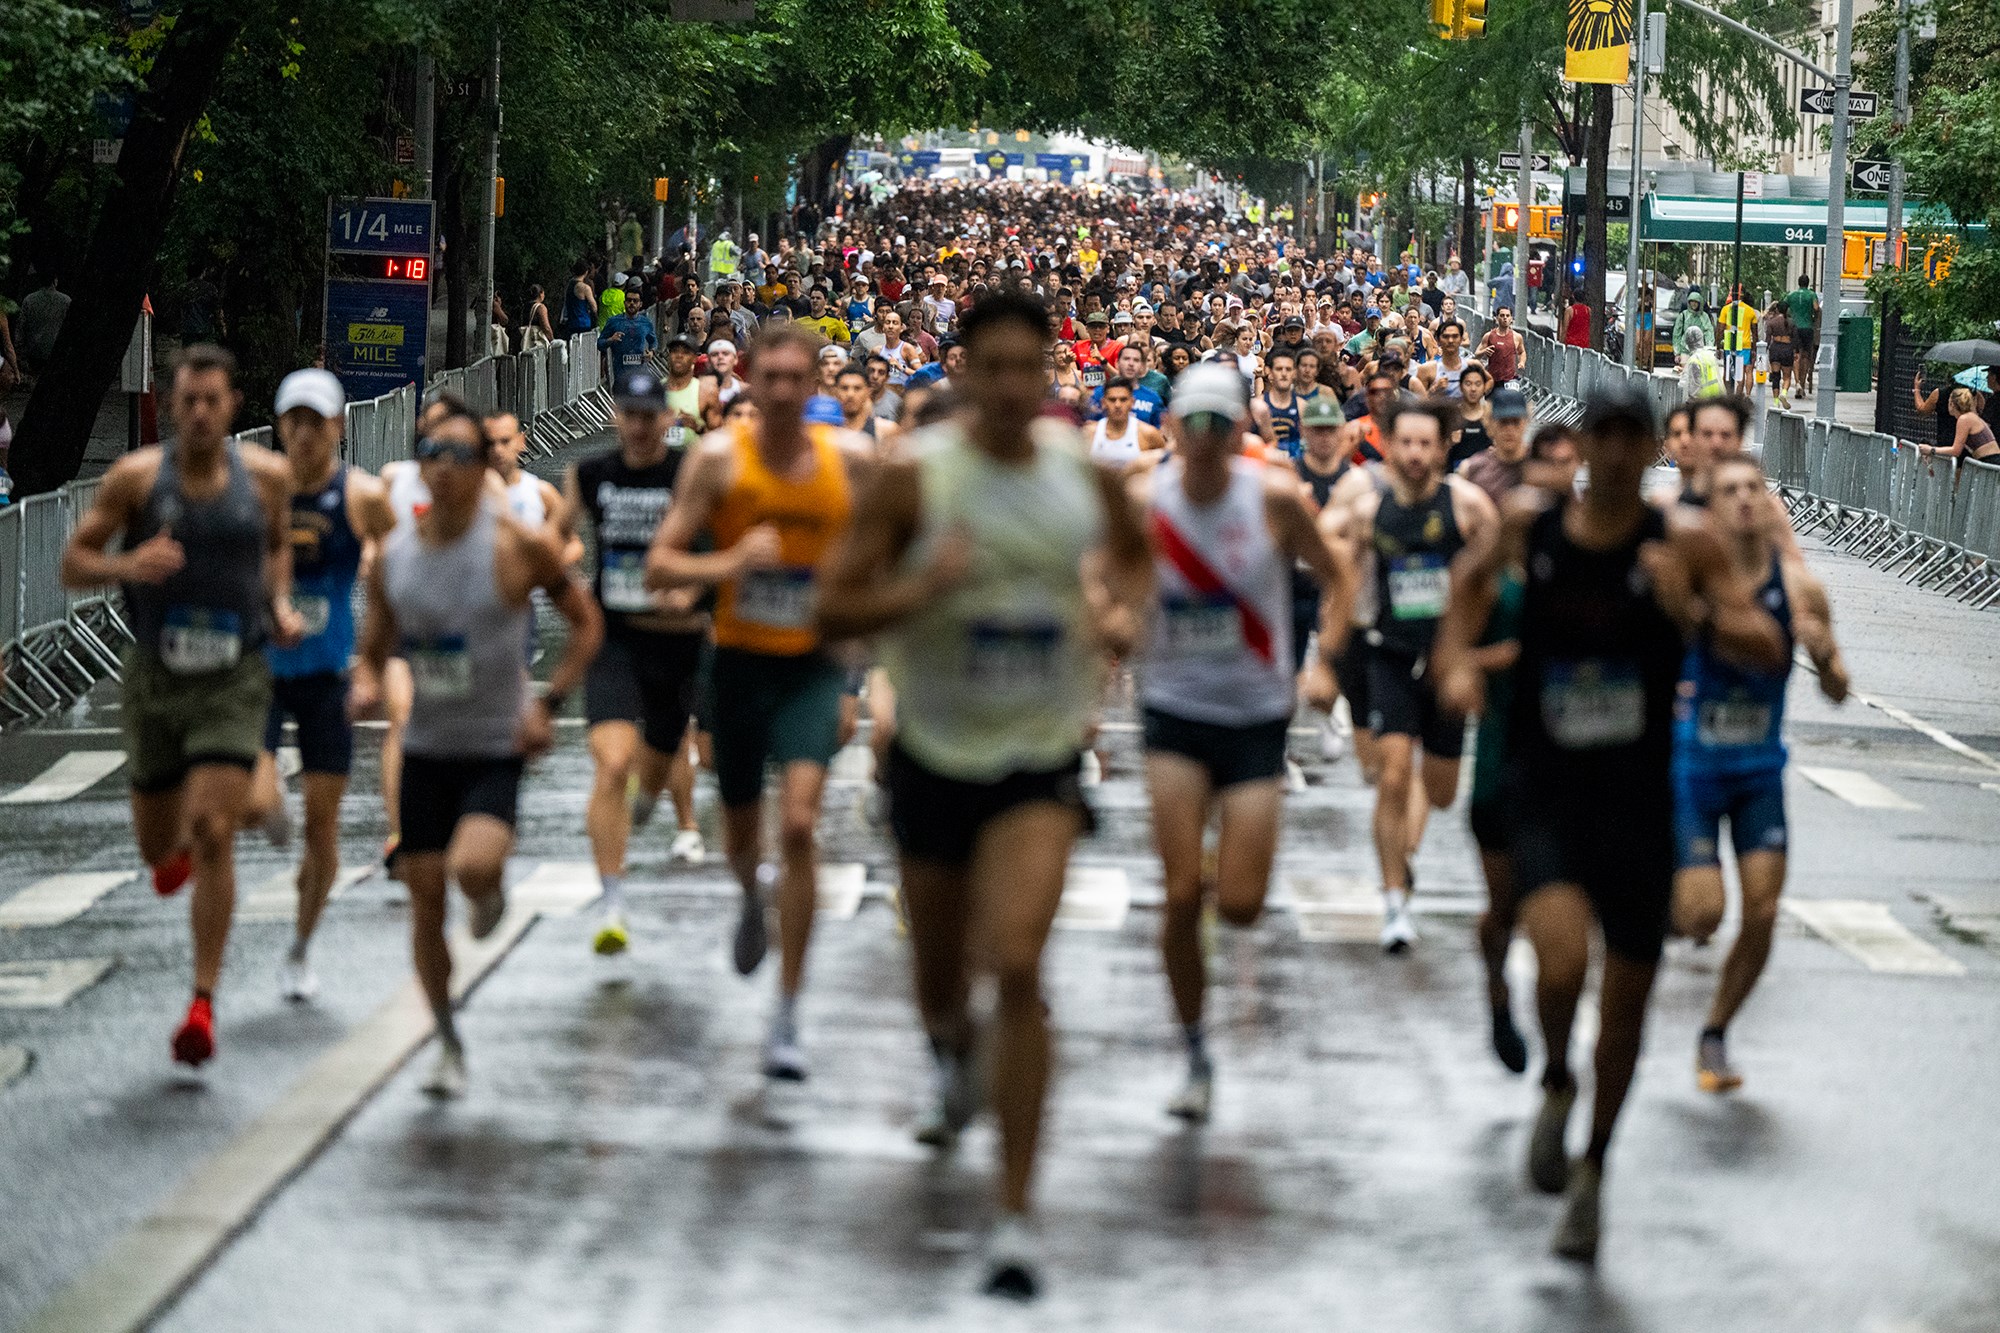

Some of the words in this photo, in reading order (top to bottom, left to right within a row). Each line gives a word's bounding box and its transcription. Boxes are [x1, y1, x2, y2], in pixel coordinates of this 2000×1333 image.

[458, 83, 469, 95] St
[1867, 170, 1890, 182] ONE
[1606, 200, 1623, 211] 45
[339, 209, 389, 243] 1/4
[394, 224, 423, 235] MILE
[1785, 227, 1814, 241] 944
[354, 328, 375, 341] 5th
[353, 346, 397, 362] MILE
